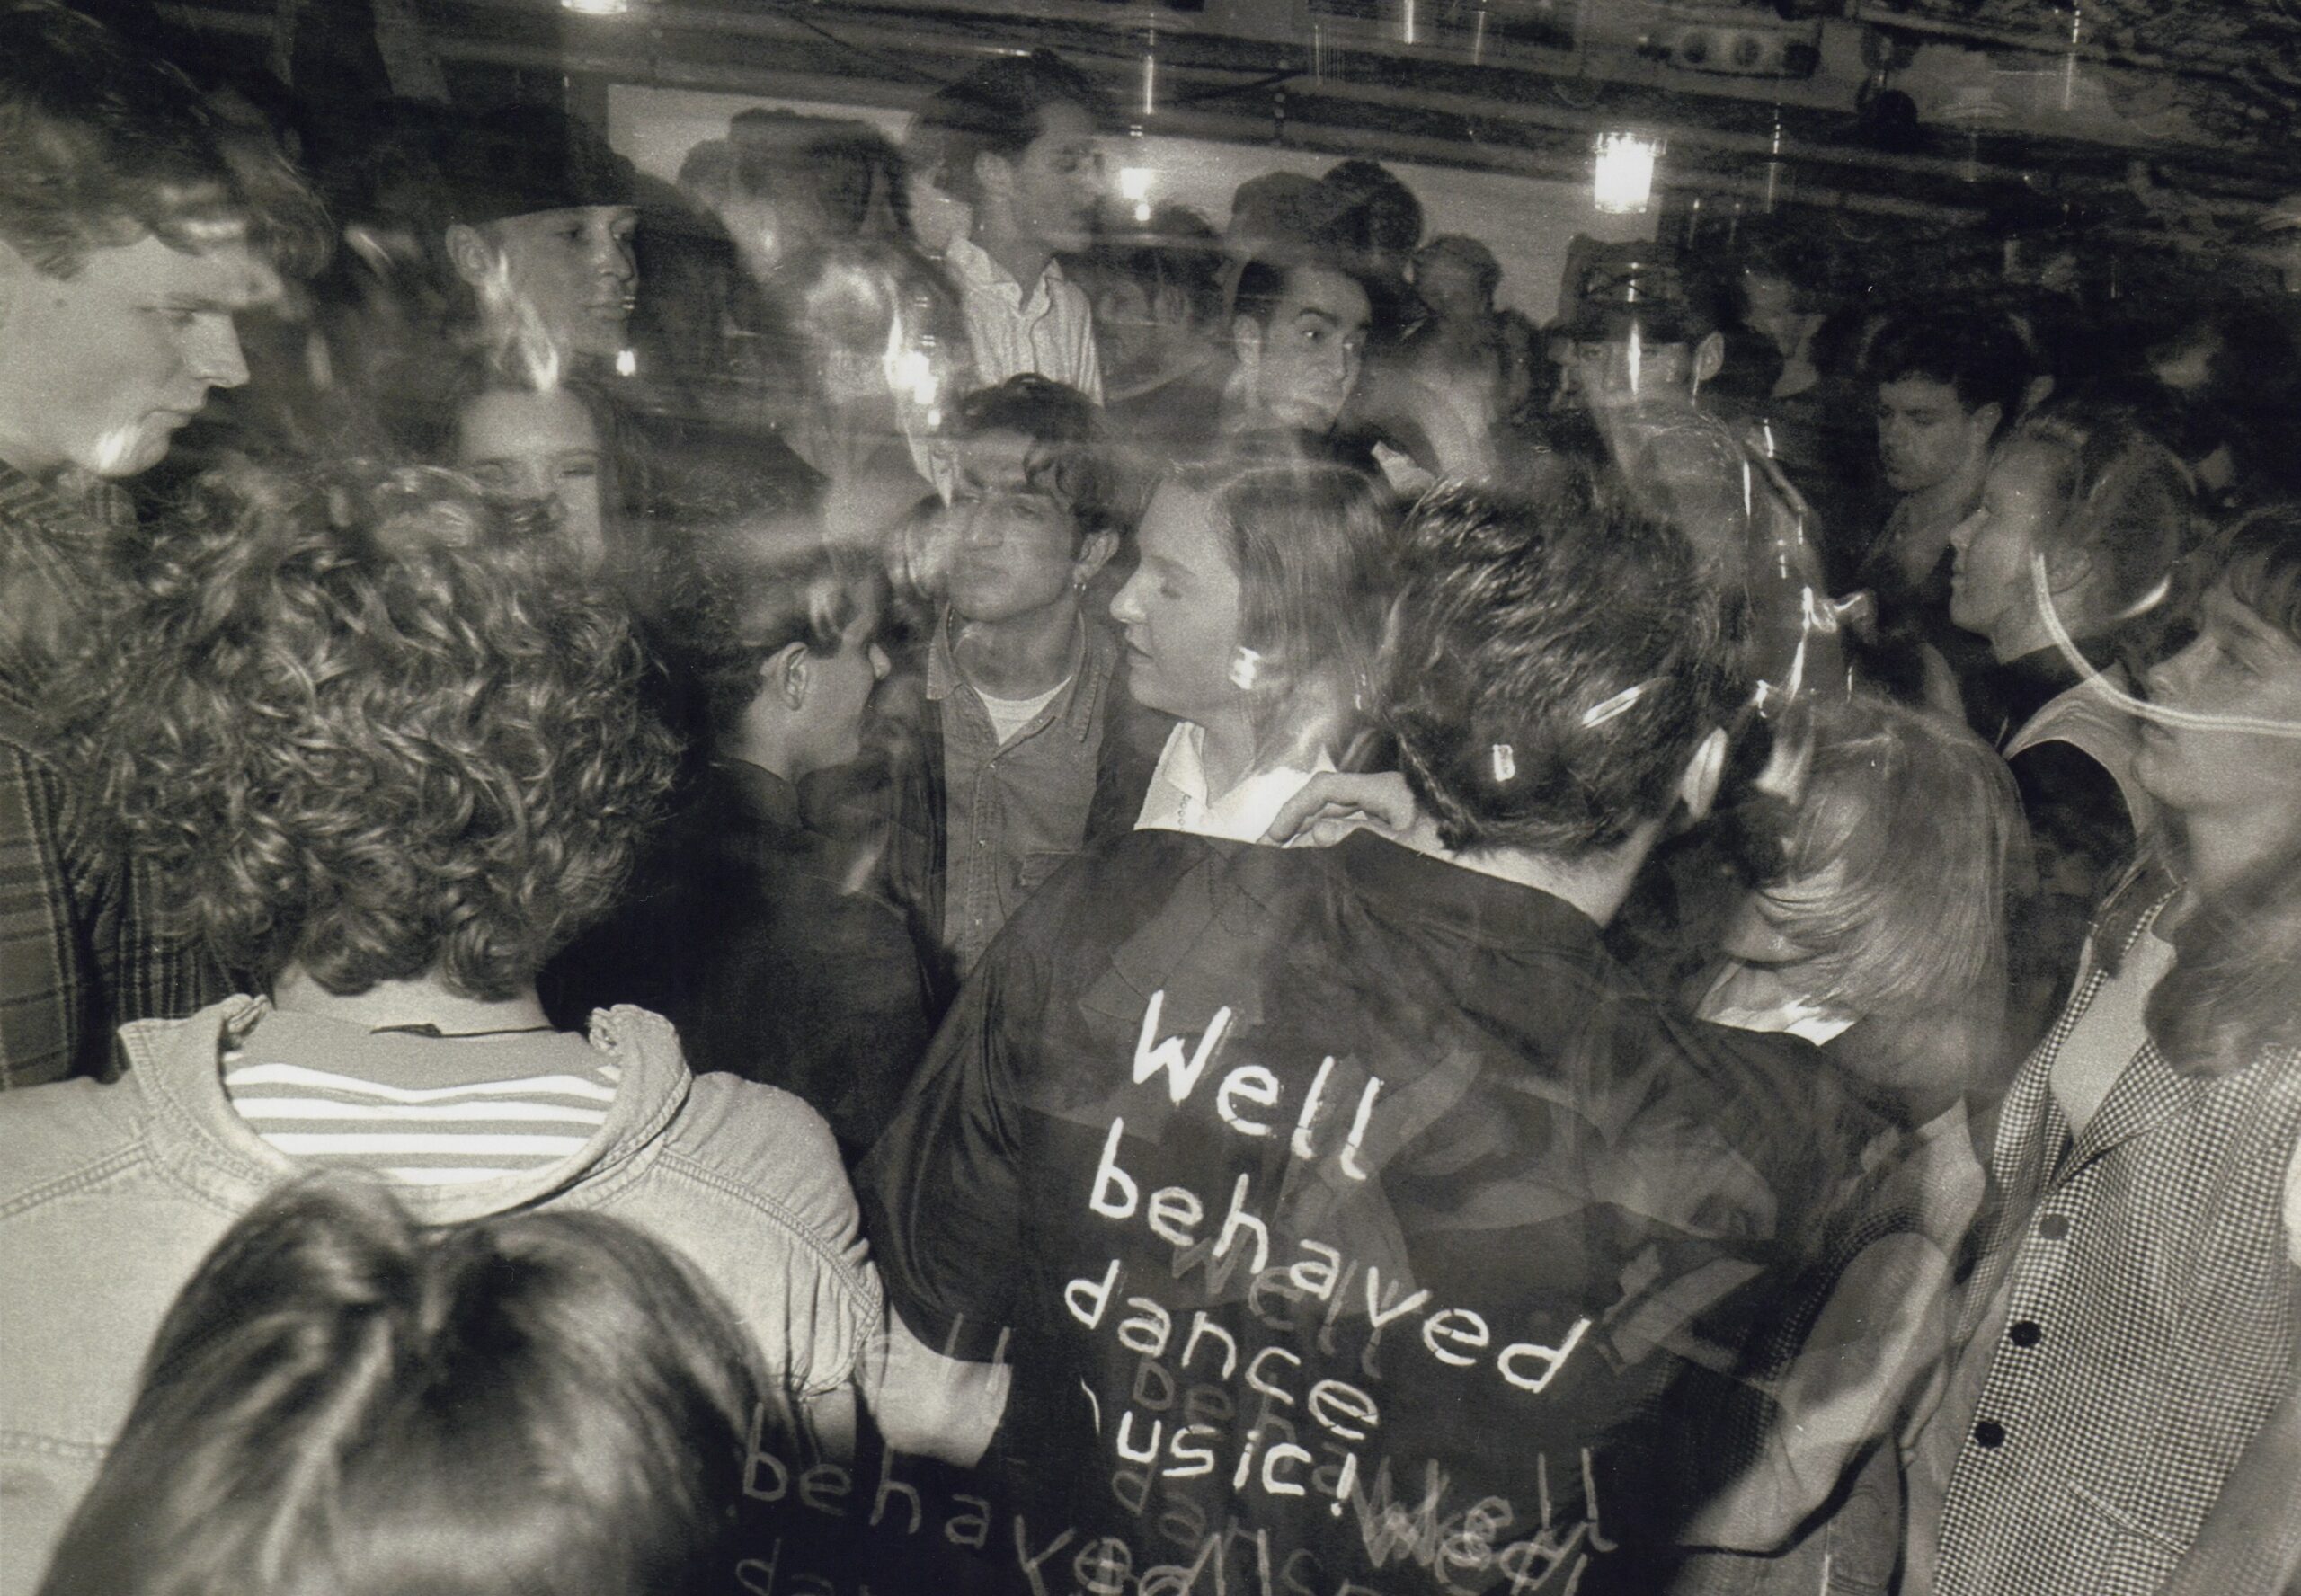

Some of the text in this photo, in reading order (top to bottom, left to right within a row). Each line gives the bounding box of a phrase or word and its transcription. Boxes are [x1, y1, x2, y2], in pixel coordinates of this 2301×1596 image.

[1133, 989, 1385, 1181] Well
[1088, 1116, 1592, 1394] behaved
[1064, 1258, 1380, 1441] dance
[1080, 1377, 1358, 1517] usic!
